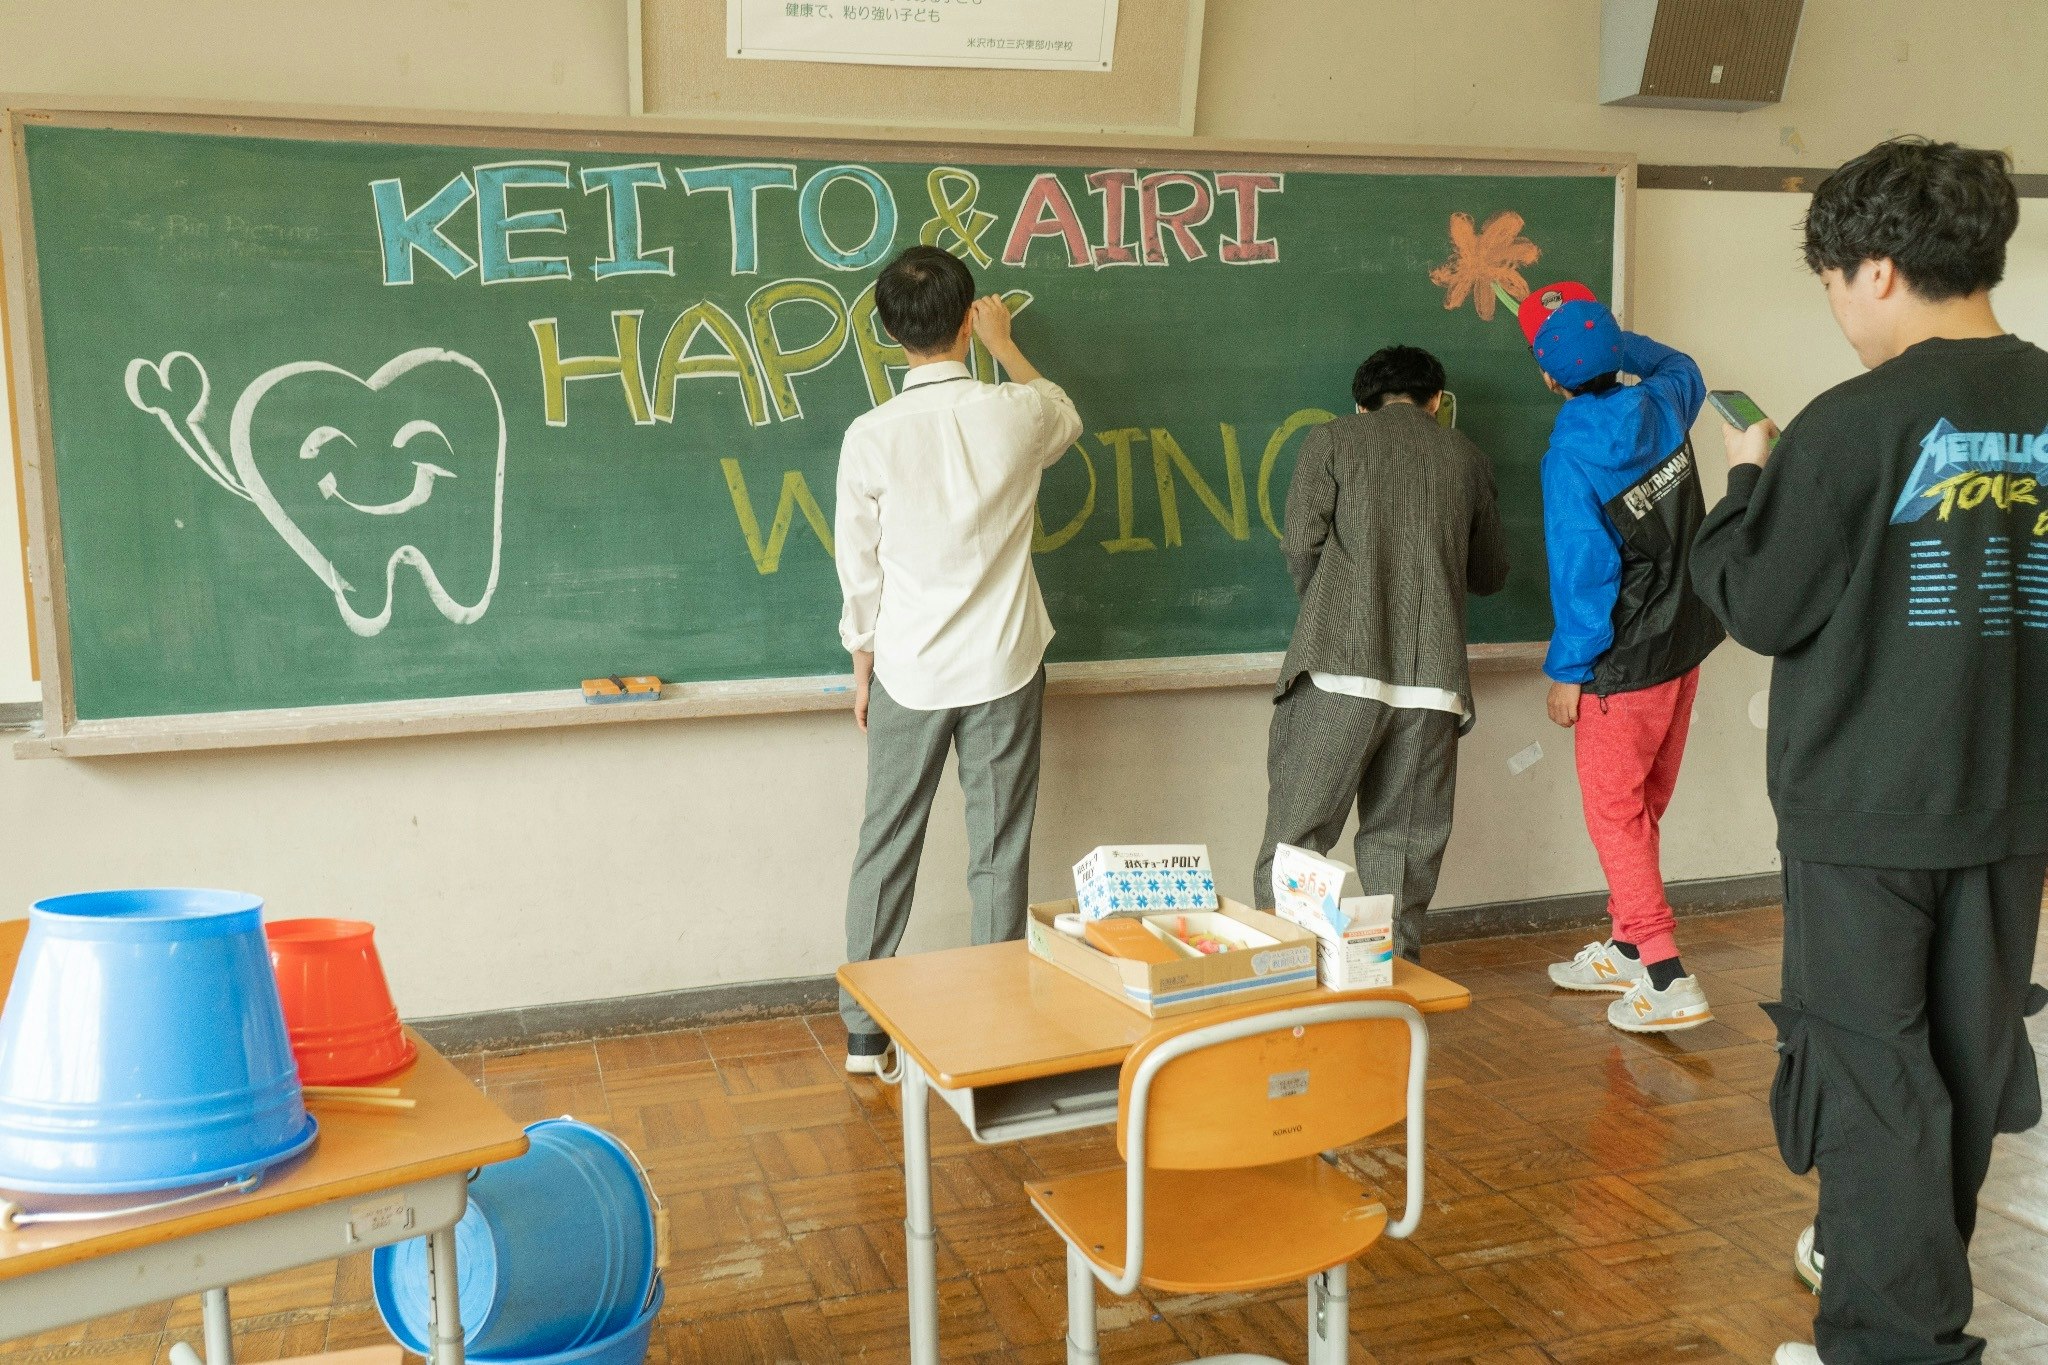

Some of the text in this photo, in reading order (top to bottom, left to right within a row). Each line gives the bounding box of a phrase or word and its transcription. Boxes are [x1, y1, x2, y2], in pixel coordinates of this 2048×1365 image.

[785, 3, 941, 23] 健康で、粘り強い子ども
[967, 37, 1073, 51] 米沢市立三沢東部小学校
[369, 160, 1286, 287] KEITO & AIRI
[1640, 451, 1690, 498] ULTRAMAN
[1890, 417, 2048, 525] METALLIC
[1171, 855, 1201, 868] POLY
[1591, 956, 1619, 980] N
[1632, 993, 1653, 1019] N
[1272, 1125, 1303, 1137] KOKUYO
